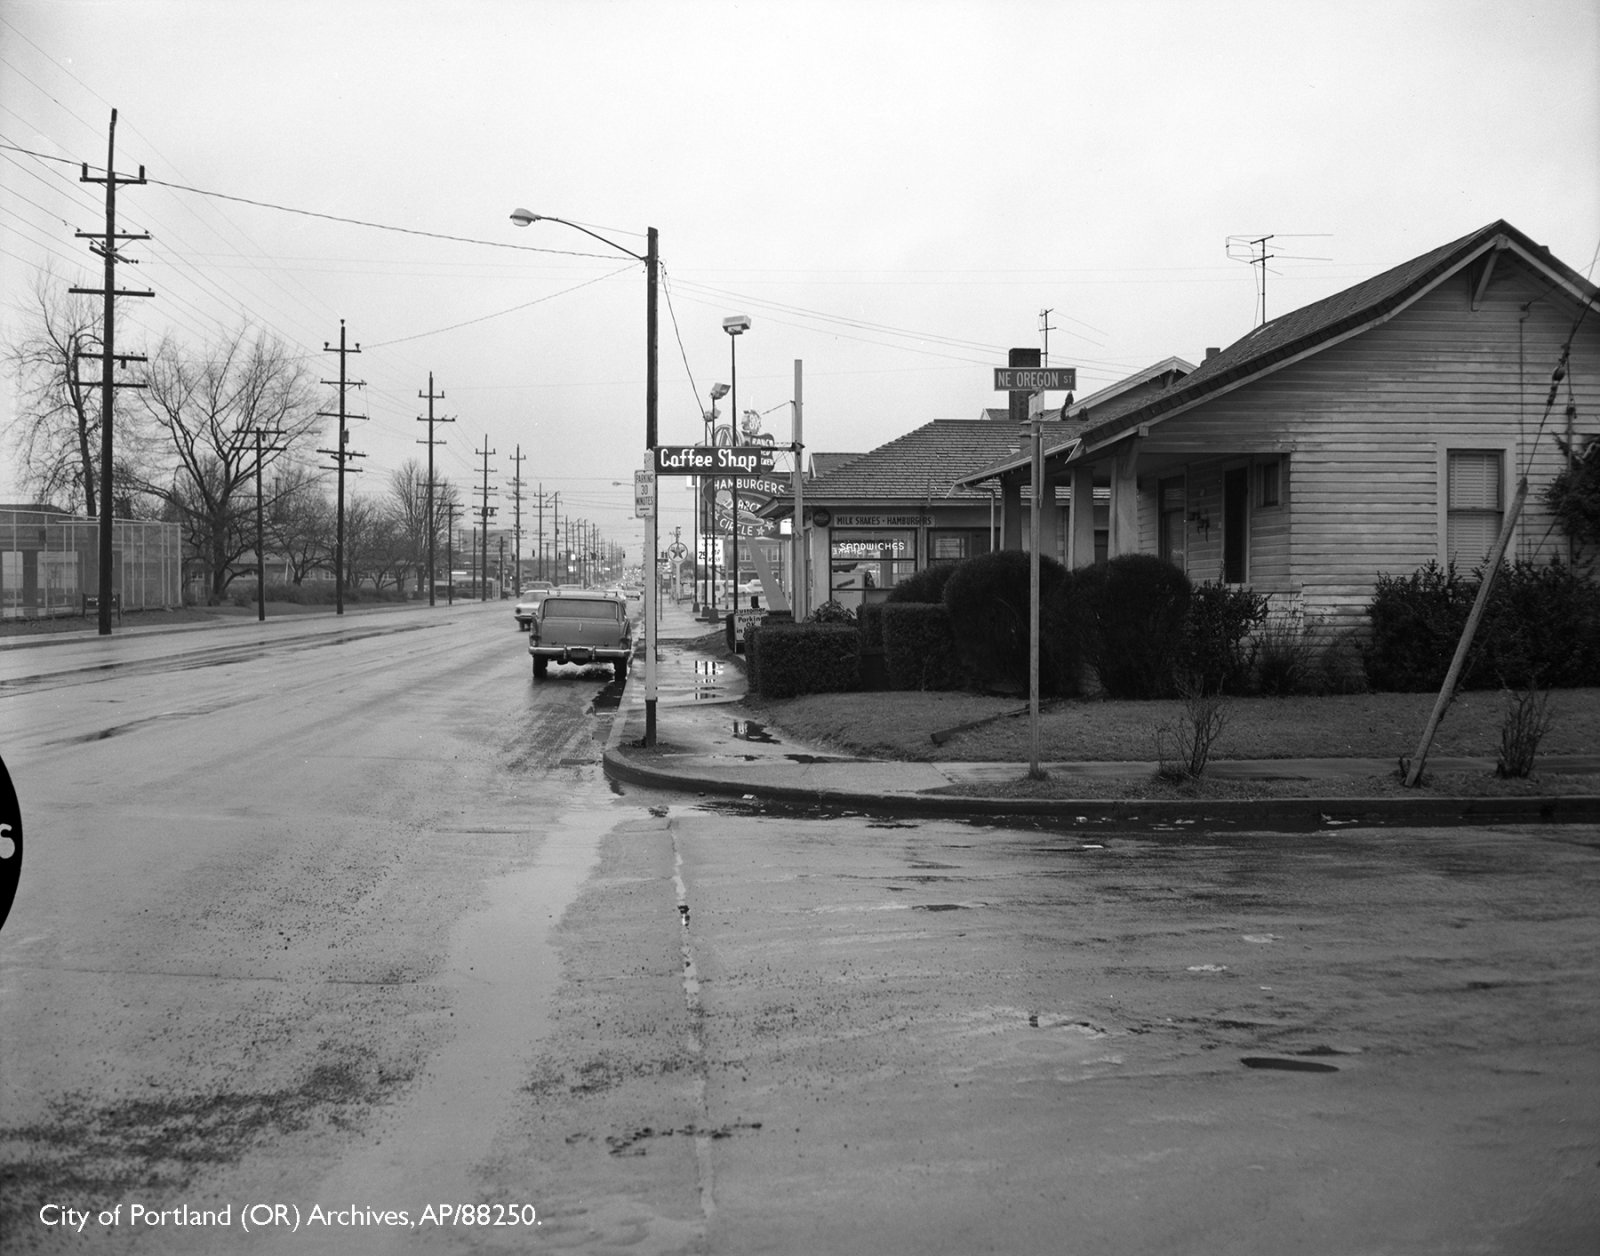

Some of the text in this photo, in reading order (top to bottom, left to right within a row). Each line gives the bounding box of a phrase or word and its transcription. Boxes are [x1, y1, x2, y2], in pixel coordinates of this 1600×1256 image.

[998, 371, 1073, 387] NE OREGON ST
[660, 448, 757, 472] Coffee Shop
[635, 474, 654, 483] PARKING
[641, 484, 649, 496] 30
[714, 478, 785, 495] HAMBURGERS
[636, 496, 654, 506] MINUTES
[836, 516, 853, 525] MILK
[855, 516, 881, 525] SHAKES
[839, 541, 905, 551] SANDWICHES
[738, 615, 762, 624] Parkin
